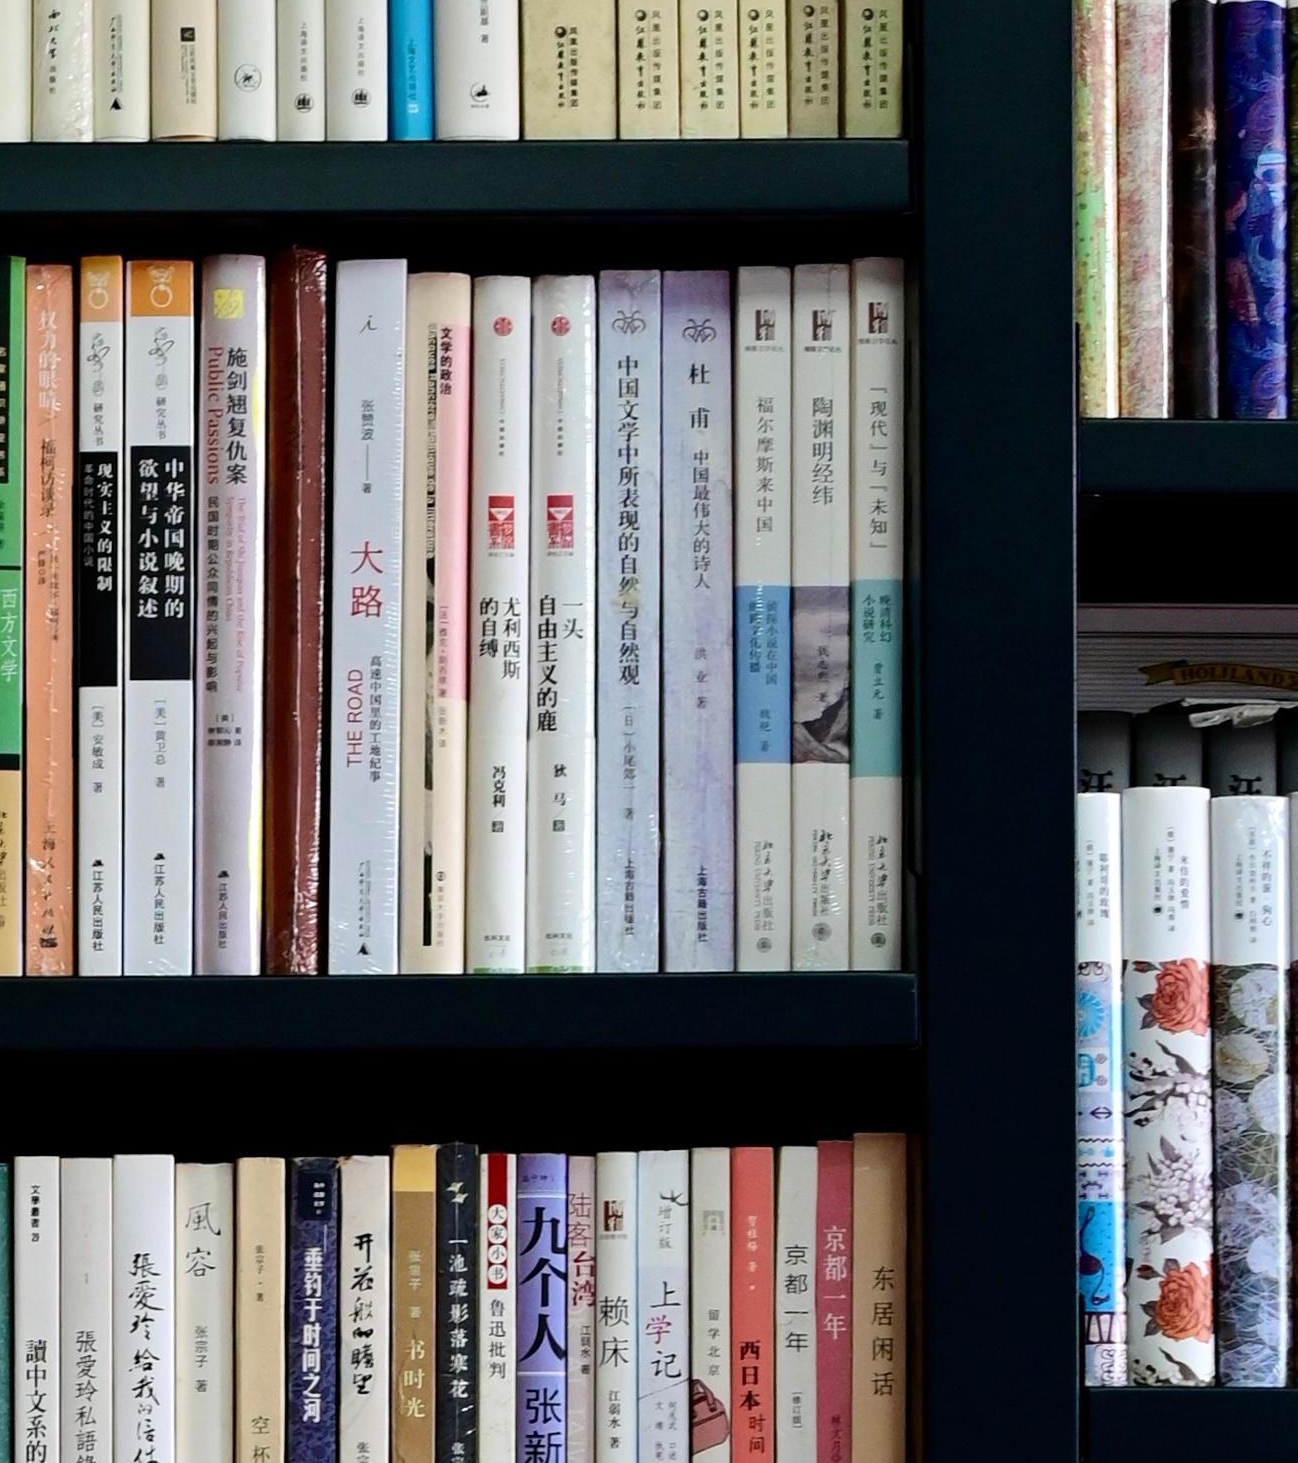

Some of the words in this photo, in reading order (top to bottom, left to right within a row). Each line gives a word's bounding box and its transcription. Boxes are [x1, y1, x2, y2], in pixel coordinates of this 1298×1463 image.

[138, 458, 159, 619] 欲望与小说叙述
[164, 457, 185, 619] 中华帝国晚期的
[351, 541, 383, 618] 大路
[521, 1206, 569, 1362] 九个人
[600, 1295, 629, 1368] 赖床
[784, 1243, 808, 1353] 京都一年
[823, 1224, 847, 1342] 京都一年
